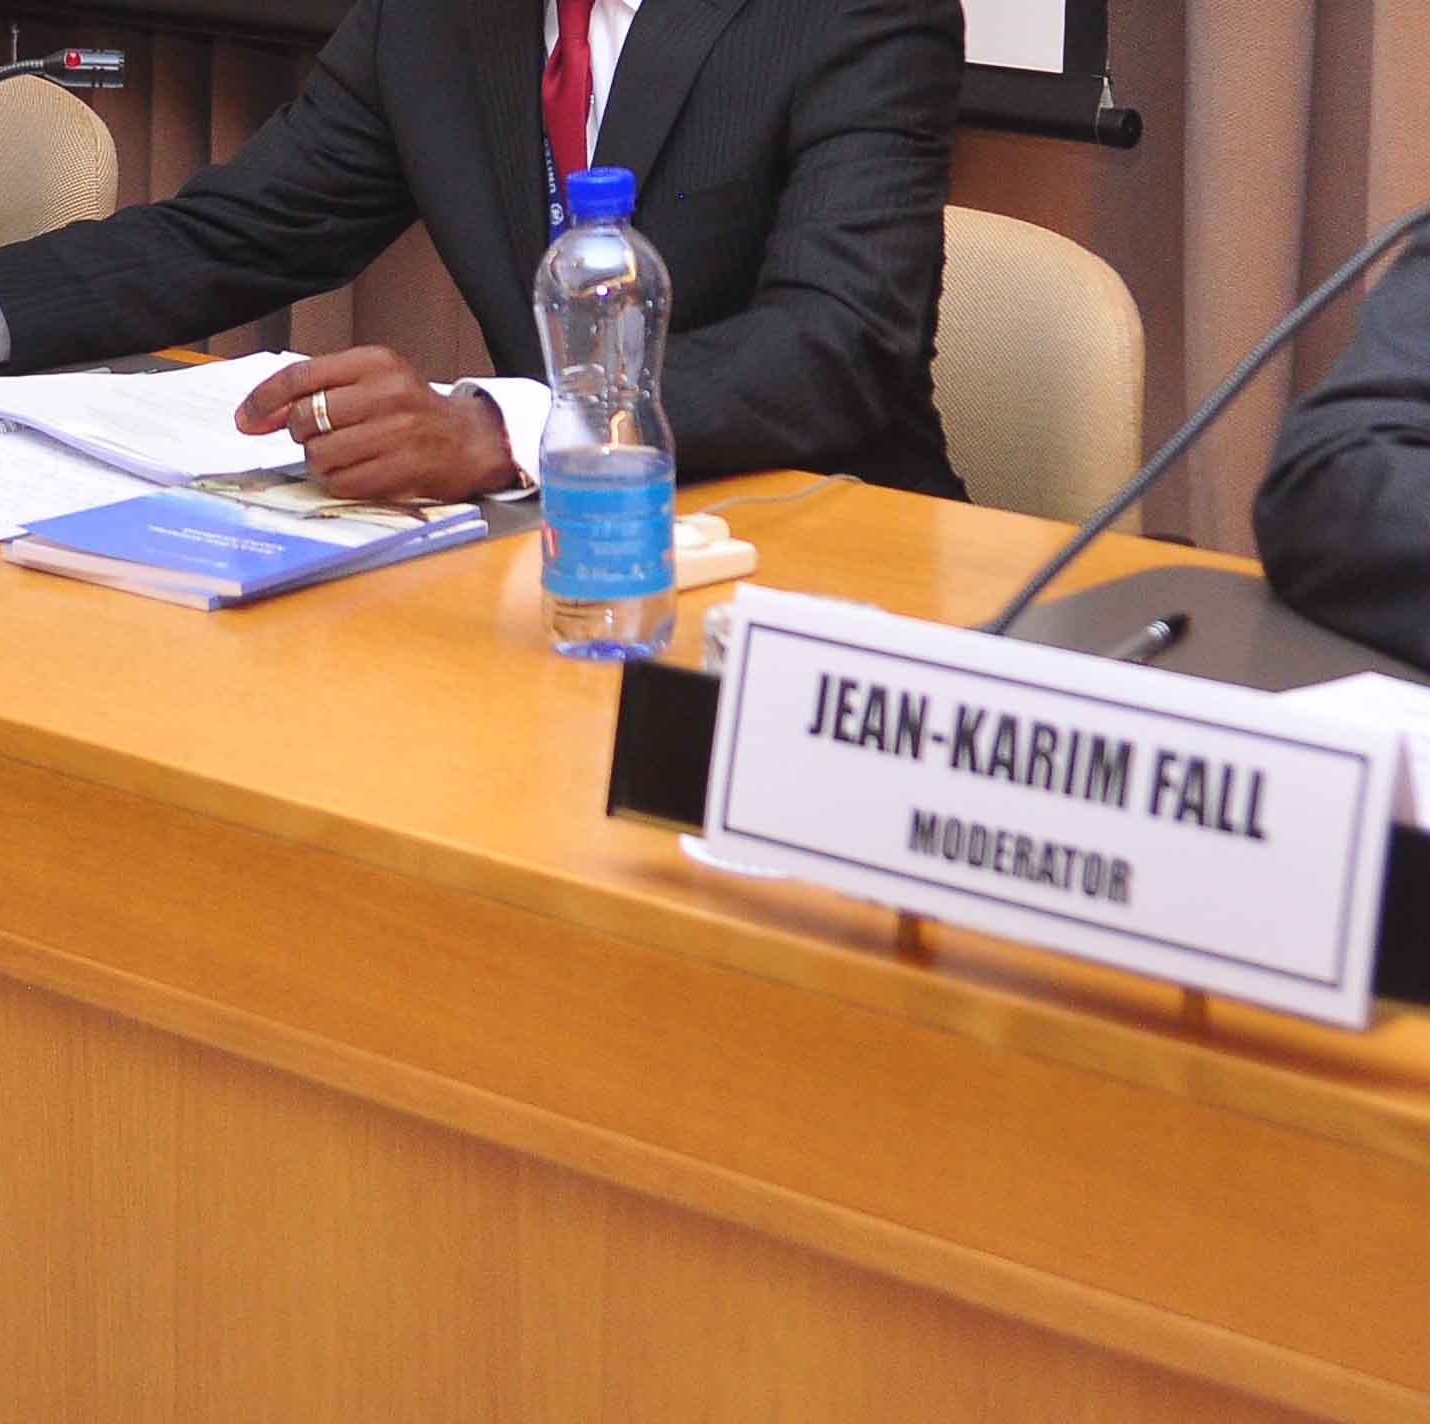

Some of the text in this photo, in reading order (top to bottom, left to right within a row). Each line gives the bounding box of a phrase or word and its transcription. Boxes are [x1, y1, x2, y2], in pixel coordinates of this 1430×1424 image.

[807, 673, 1266, 842] JEAN-KARIM FALL
[908, 809, 1132, 905] MODERATOR
